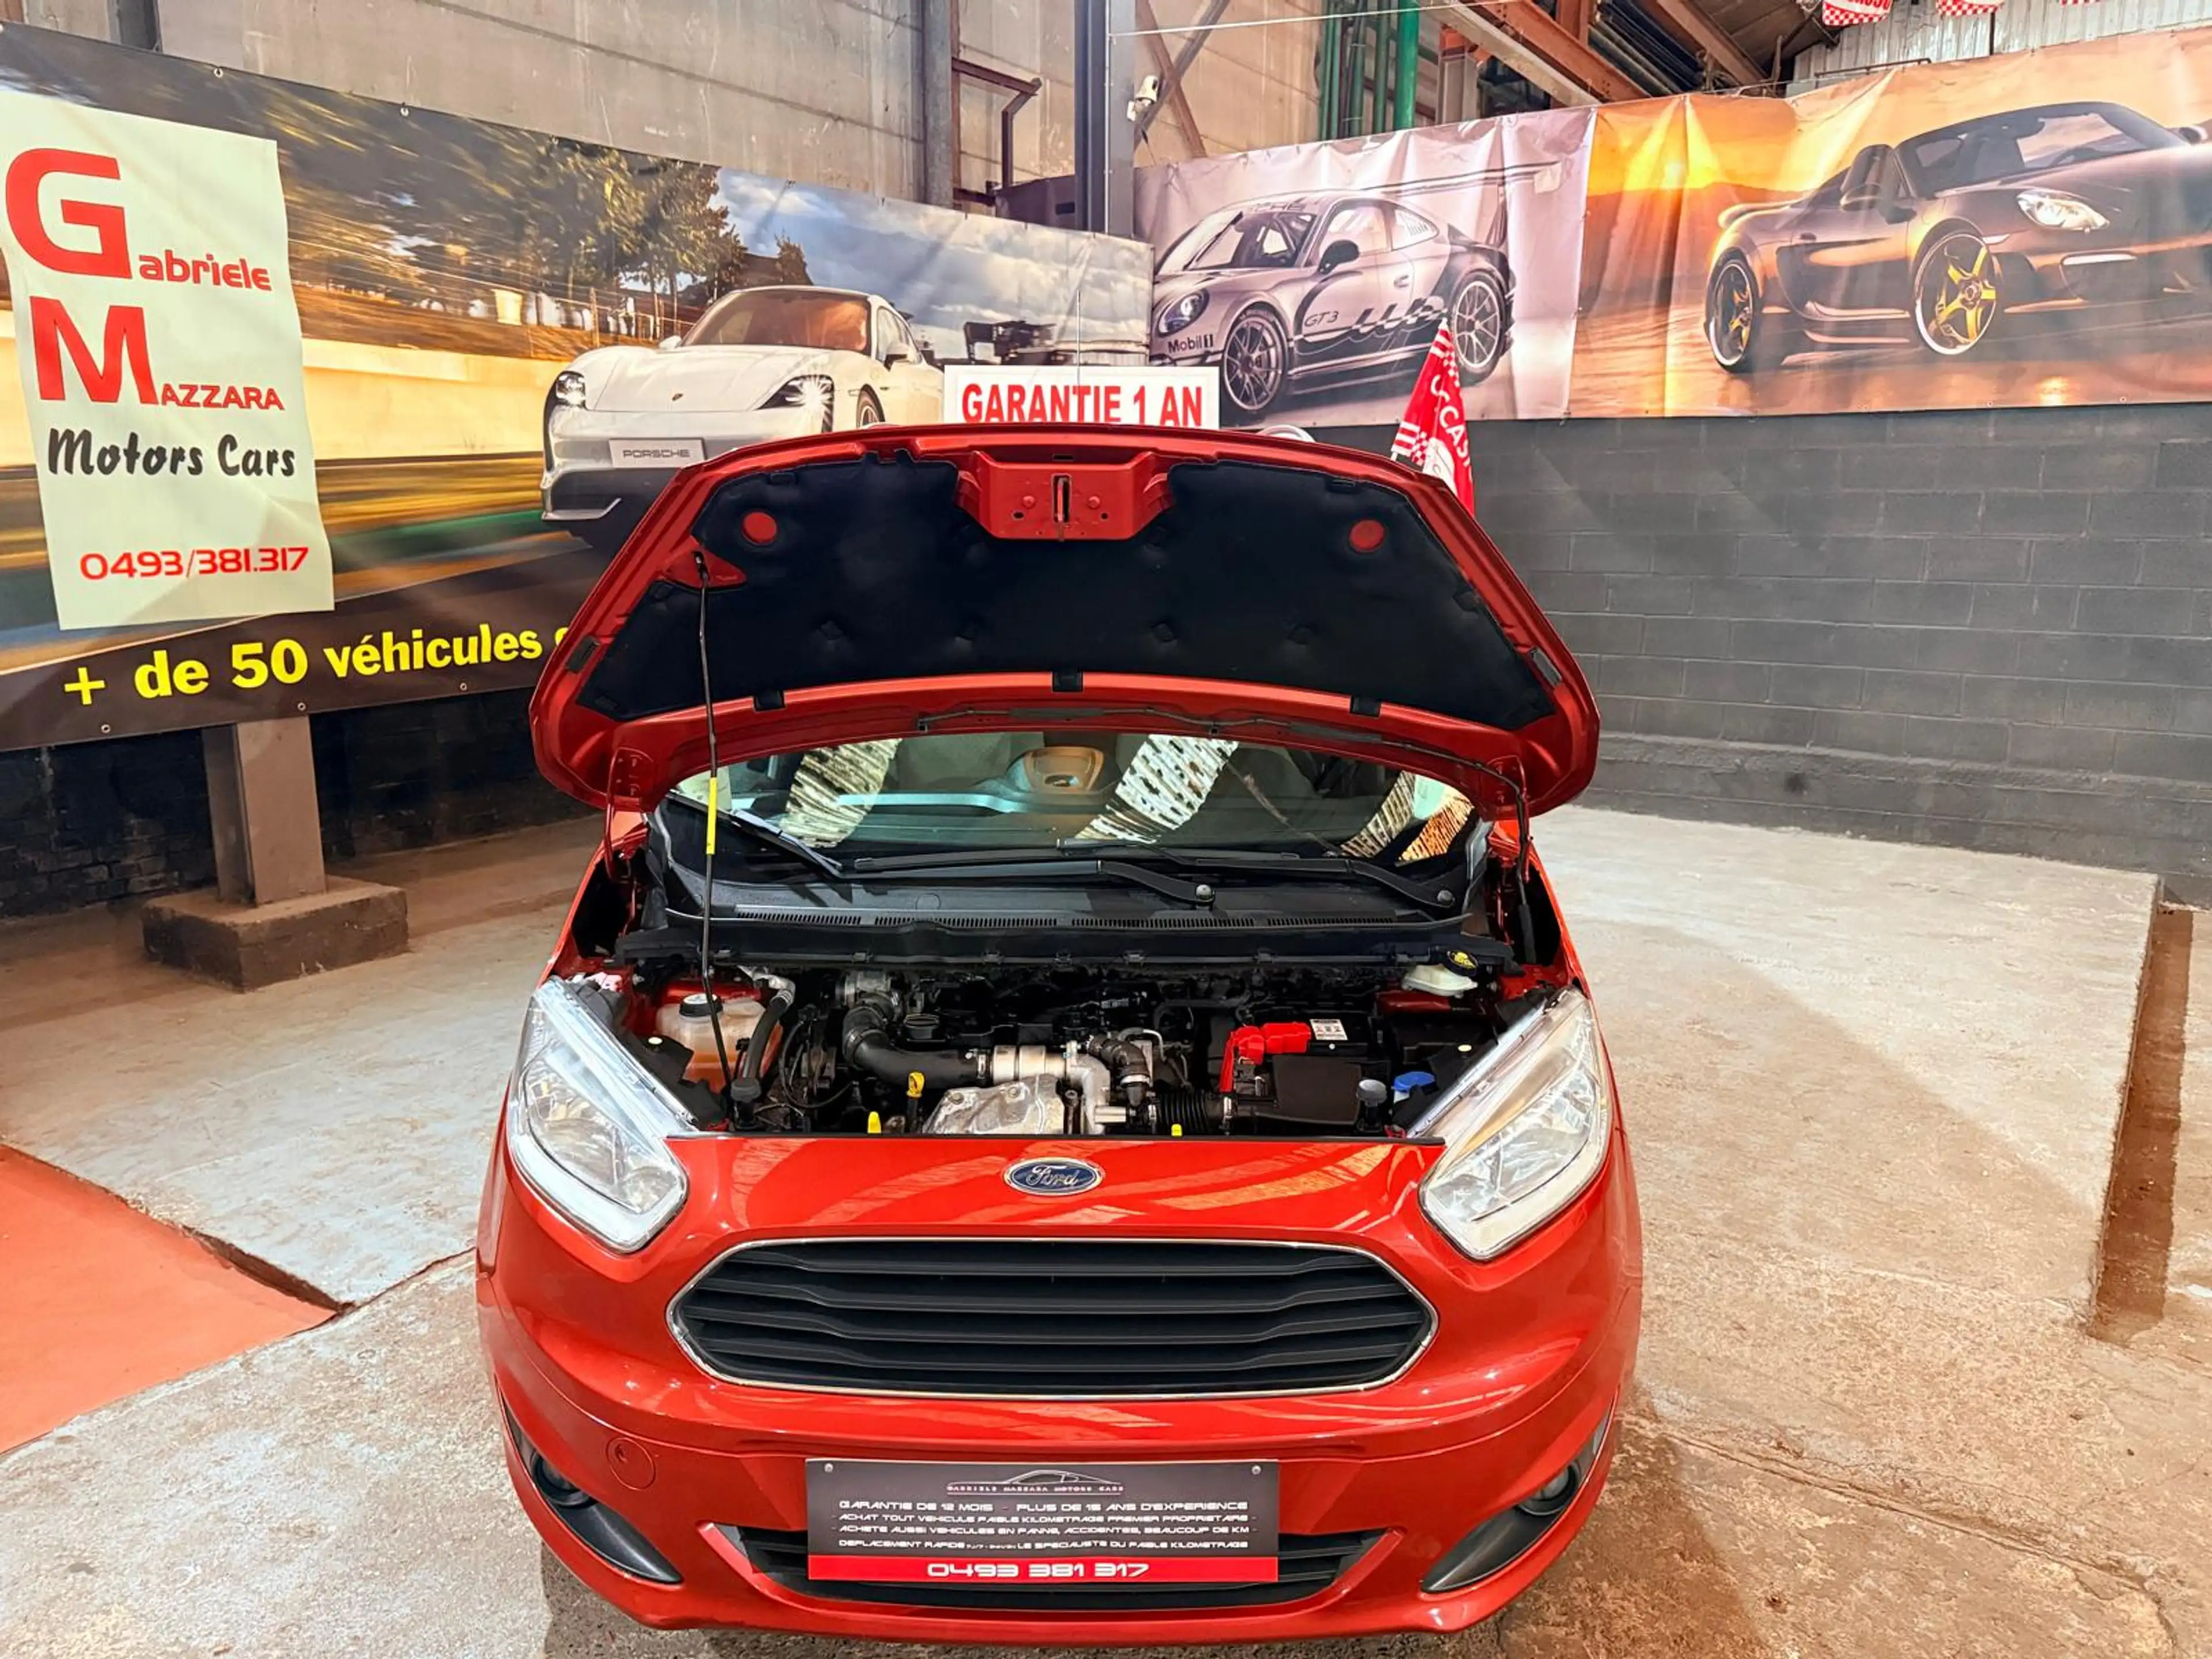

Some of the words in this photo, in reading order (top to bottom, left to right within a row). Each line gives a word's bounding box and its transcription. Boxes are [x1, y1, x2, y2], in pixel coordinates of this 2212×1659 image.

[5, 147, 272, 291] Gabriele
[1168, 335, 1203, 353] Mobil
[962, 382, 1121, 424] GARANTIE
[1133, 385, 1146, 426] 1
[1159, 386, 1202, 427] AN
[48, 428, 203, 475] Motors
[218, 434, 296, 476] Cars
[623, 449, 690, 459] PORSCHE
[79, 547, 309, 580] 0493/381.317
[65, 667, 105, 704] +
[134, 650, 209, 699] de
[232, 639, 308, 688] 50
[324, 623, 543, 679] véhicules
[1026, 1165, 1081, 1187] Ford
[839, 1501, 913, 1510] GARANTIE
[916, 1502, 937, 1511] DE
[941, 1503, 955, 1511] 12
[959, 1503, 994, 1512] MOIS
[1016, 1503, 1057, 1512] PLUS
[1061, 1503, 1082, 1512] DE
[1106, 1503, 1137, 1512] ANS
[1141, 1501, 1248, 1511] D'EXPERIENCE
[839, 1525, 888, 1533] ACHETE
[839, 1539, 922, 1548] DEPLACEMENT
[1035, 1540, 1107, 1550] SPECIALISTE
[927, 1563, 1019, 1577] 0493
[1029, 1563, 1085, 1577] 381
[1094, 1562, 1149, 1577] 317
